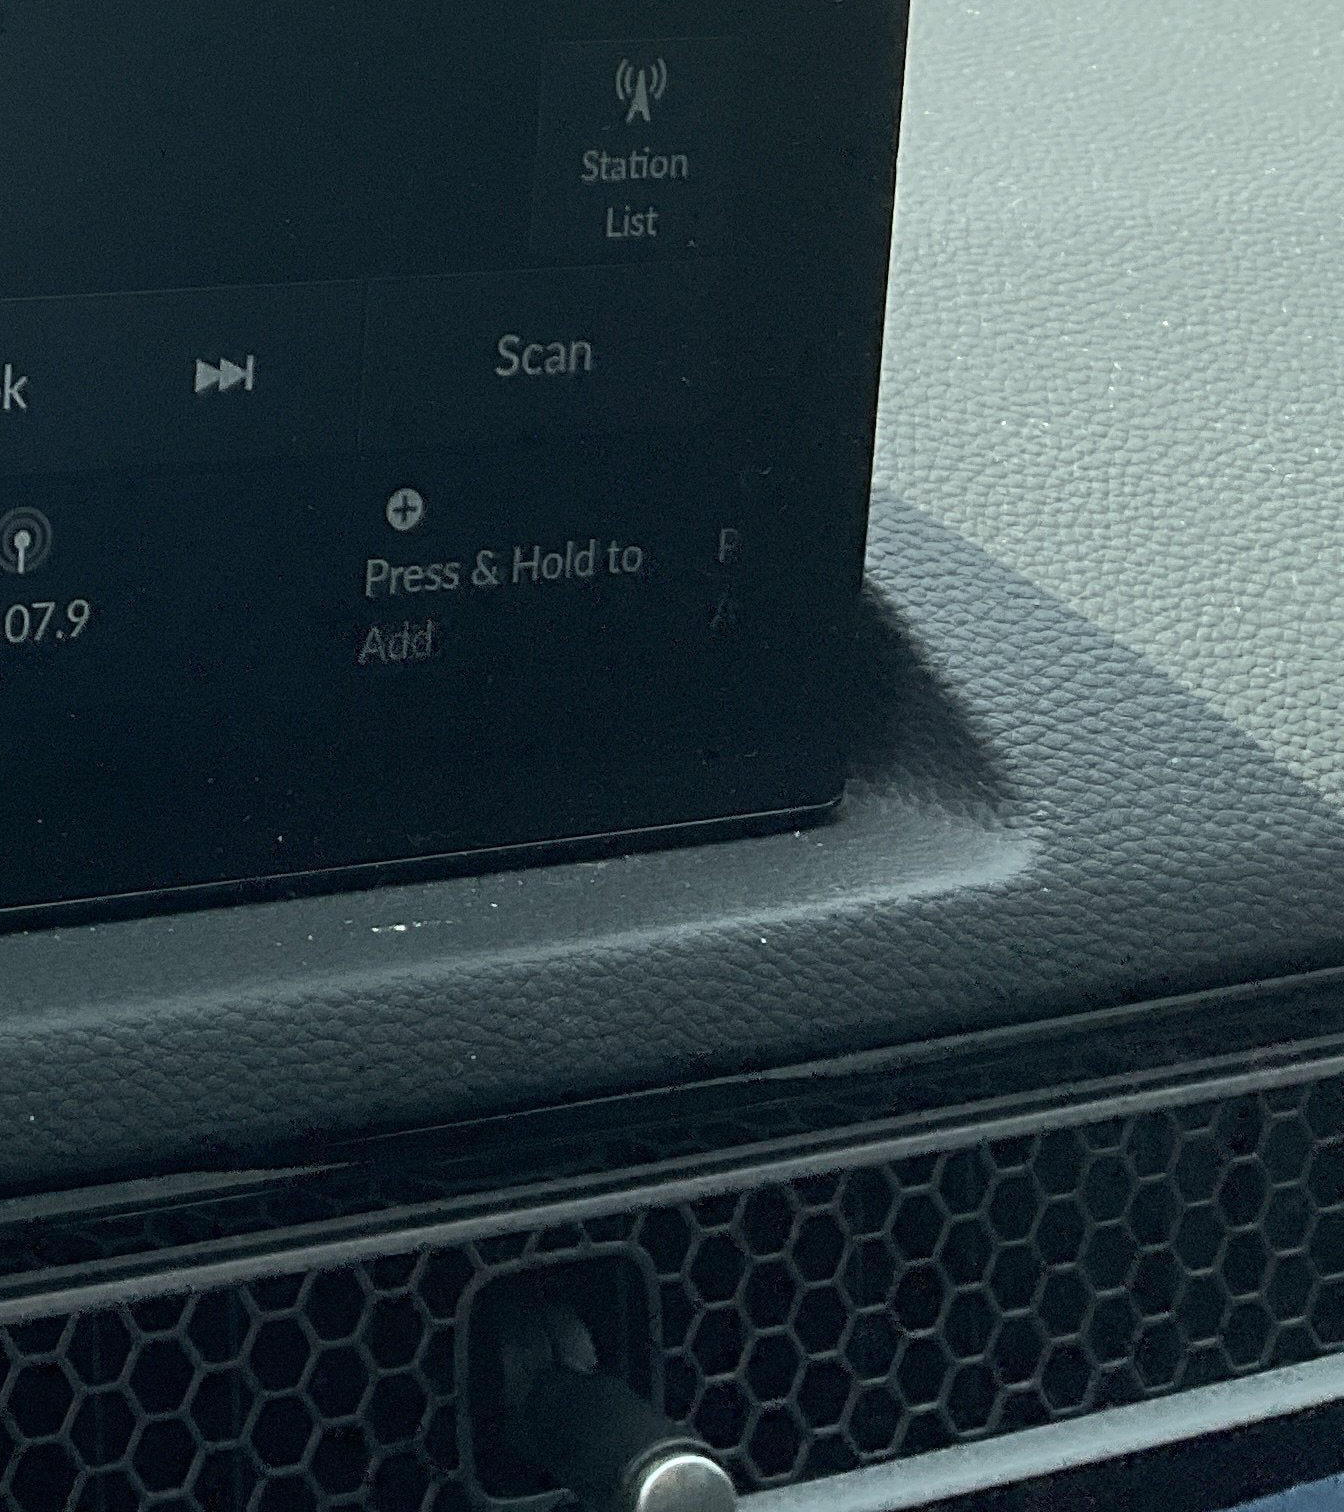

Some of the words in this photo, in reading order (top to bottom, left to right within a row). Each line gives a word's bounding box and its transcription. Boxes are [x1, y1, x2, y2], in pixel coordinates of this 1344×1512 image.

[580, 146, 689, 182] Station
[605, 204, 659, 238] List
[494, 333, 594, 377] Scan
[364, 558, 461, 598] Press
[470, 550, 500, 587] &
[512, 538, 597, 584] Hold
[608, 540, 644, 575] to
[357, 619, 434, 666] Add
